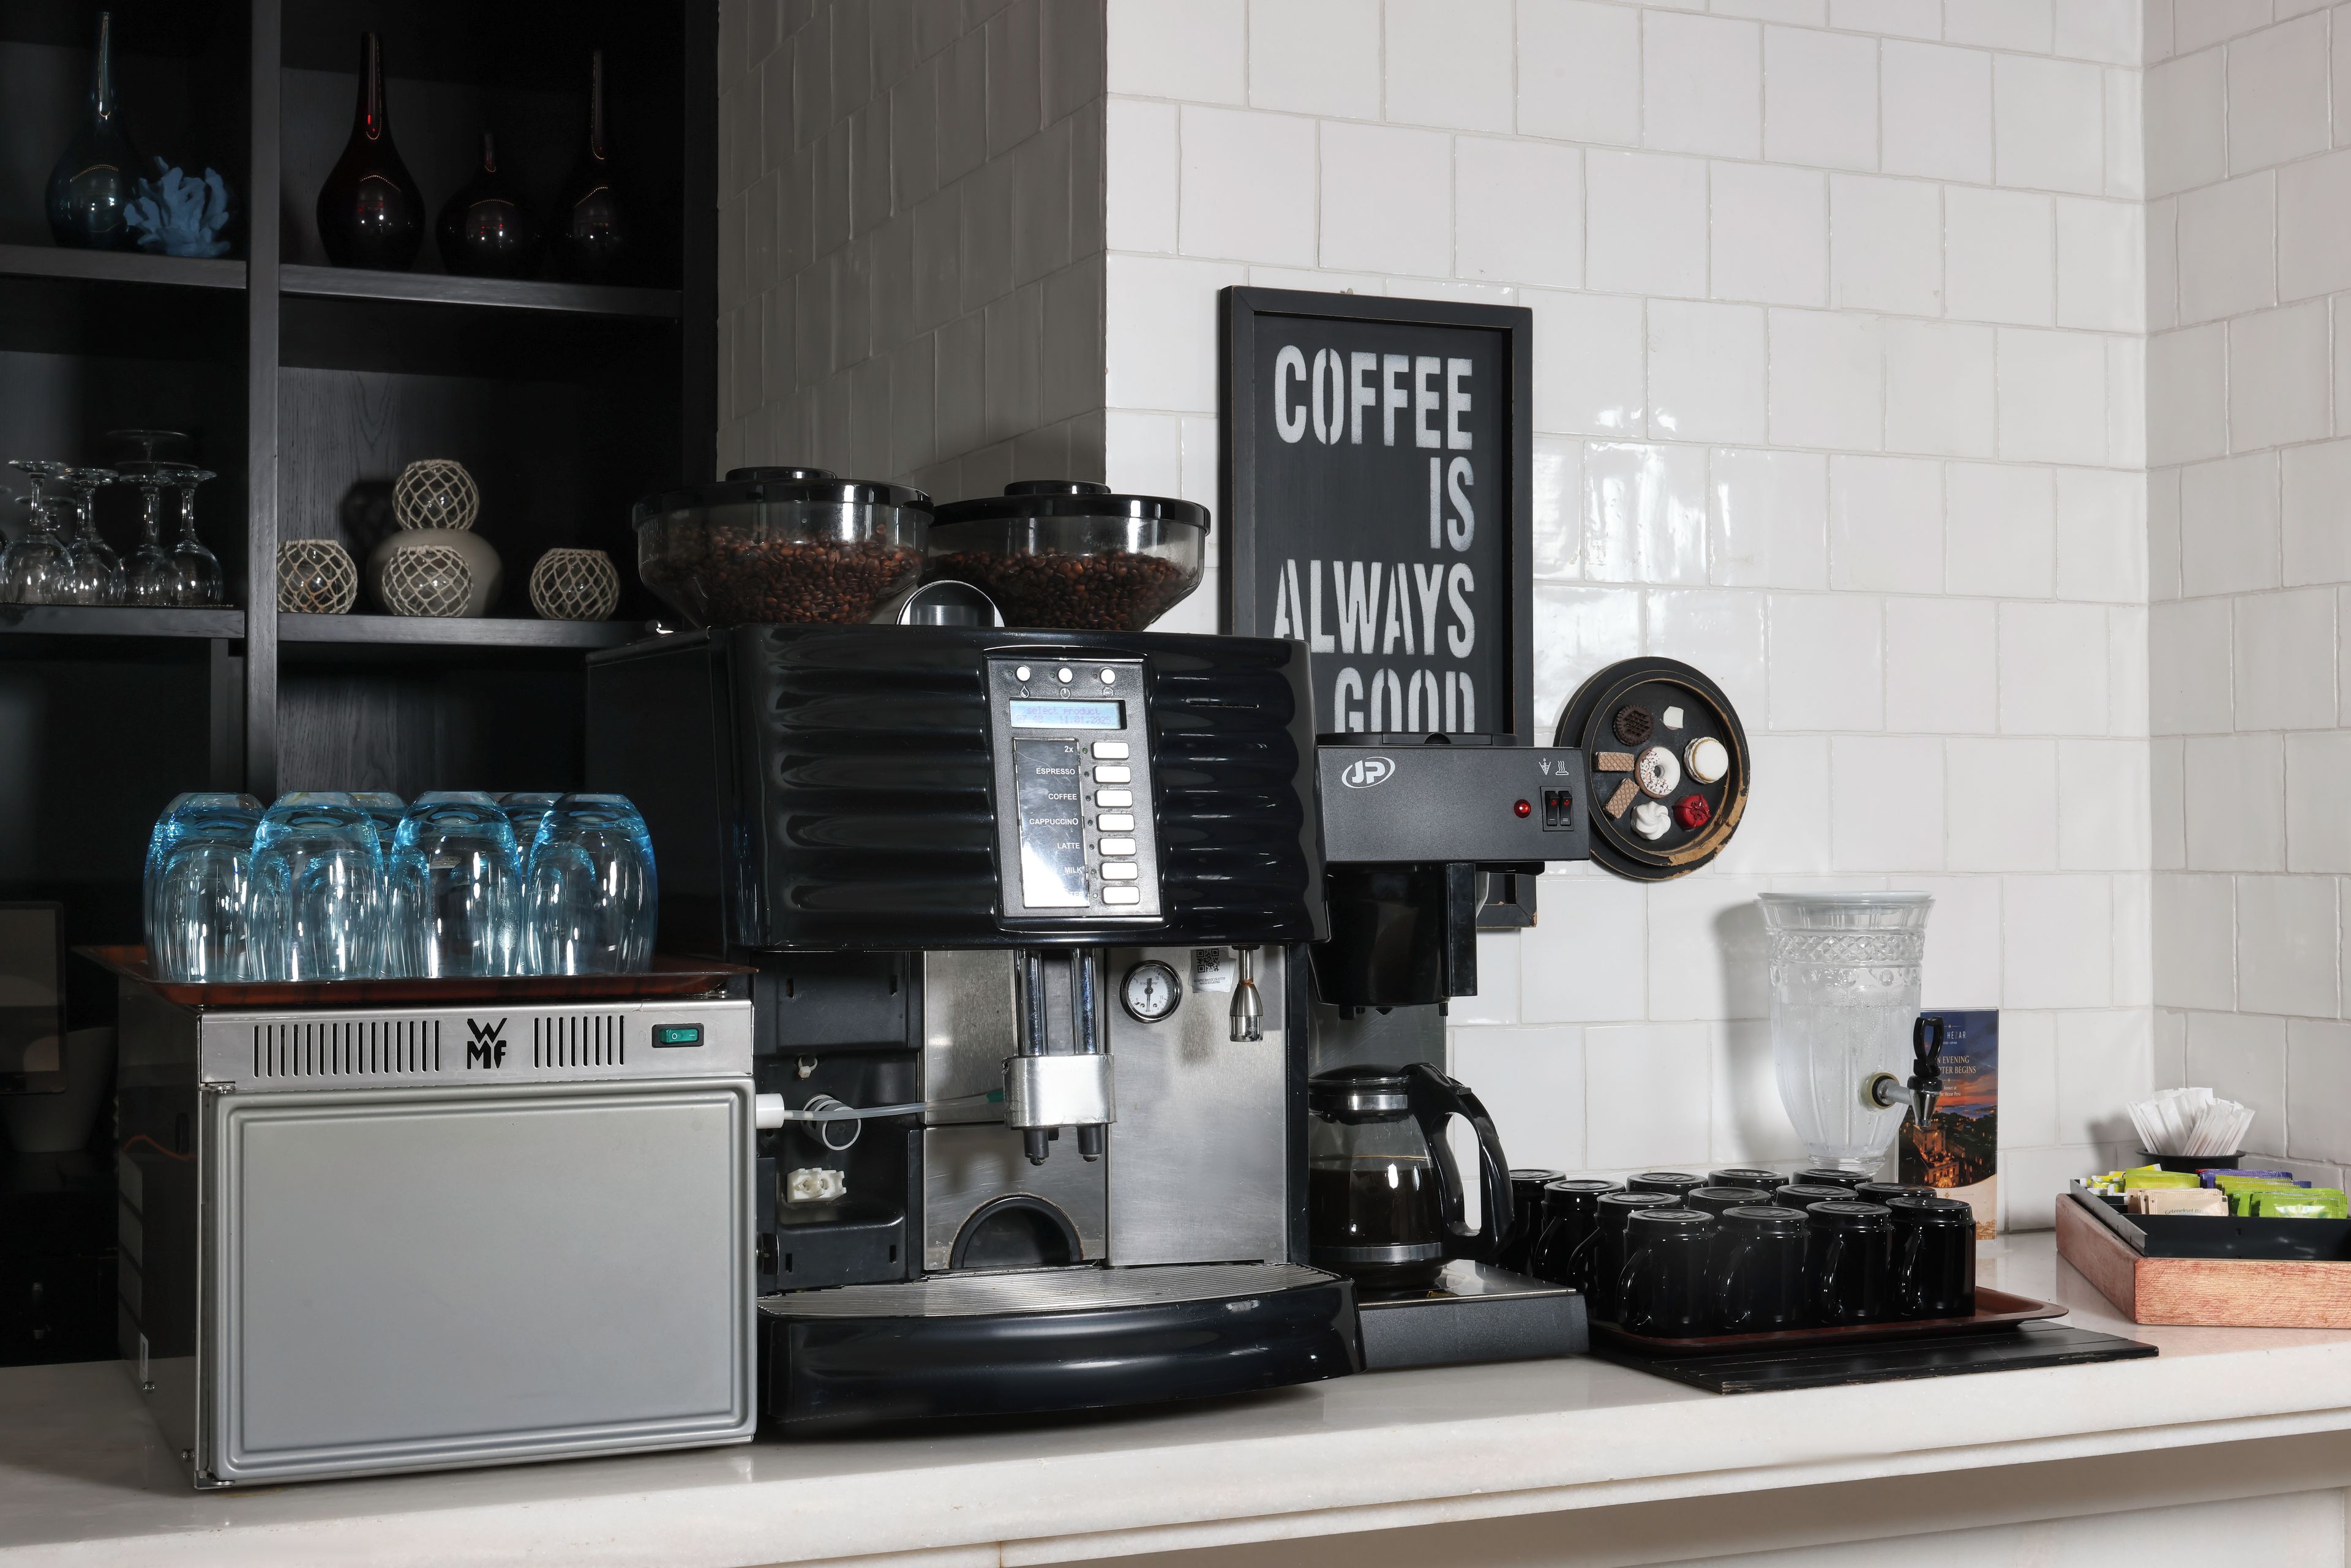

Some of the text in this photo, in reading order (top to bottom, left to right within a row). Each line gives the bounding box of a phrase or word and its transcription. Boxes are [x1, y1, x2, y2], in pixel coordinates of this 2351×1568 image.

[1274, 345, 1473, 450] COFFEE
[1429, 456, 1475, 552] IS
[1273, 558, 1475, 659] ALWAYS
[1333, 667, 1475, 733] GOOD
[1351, 759, 1387, 784] JP
